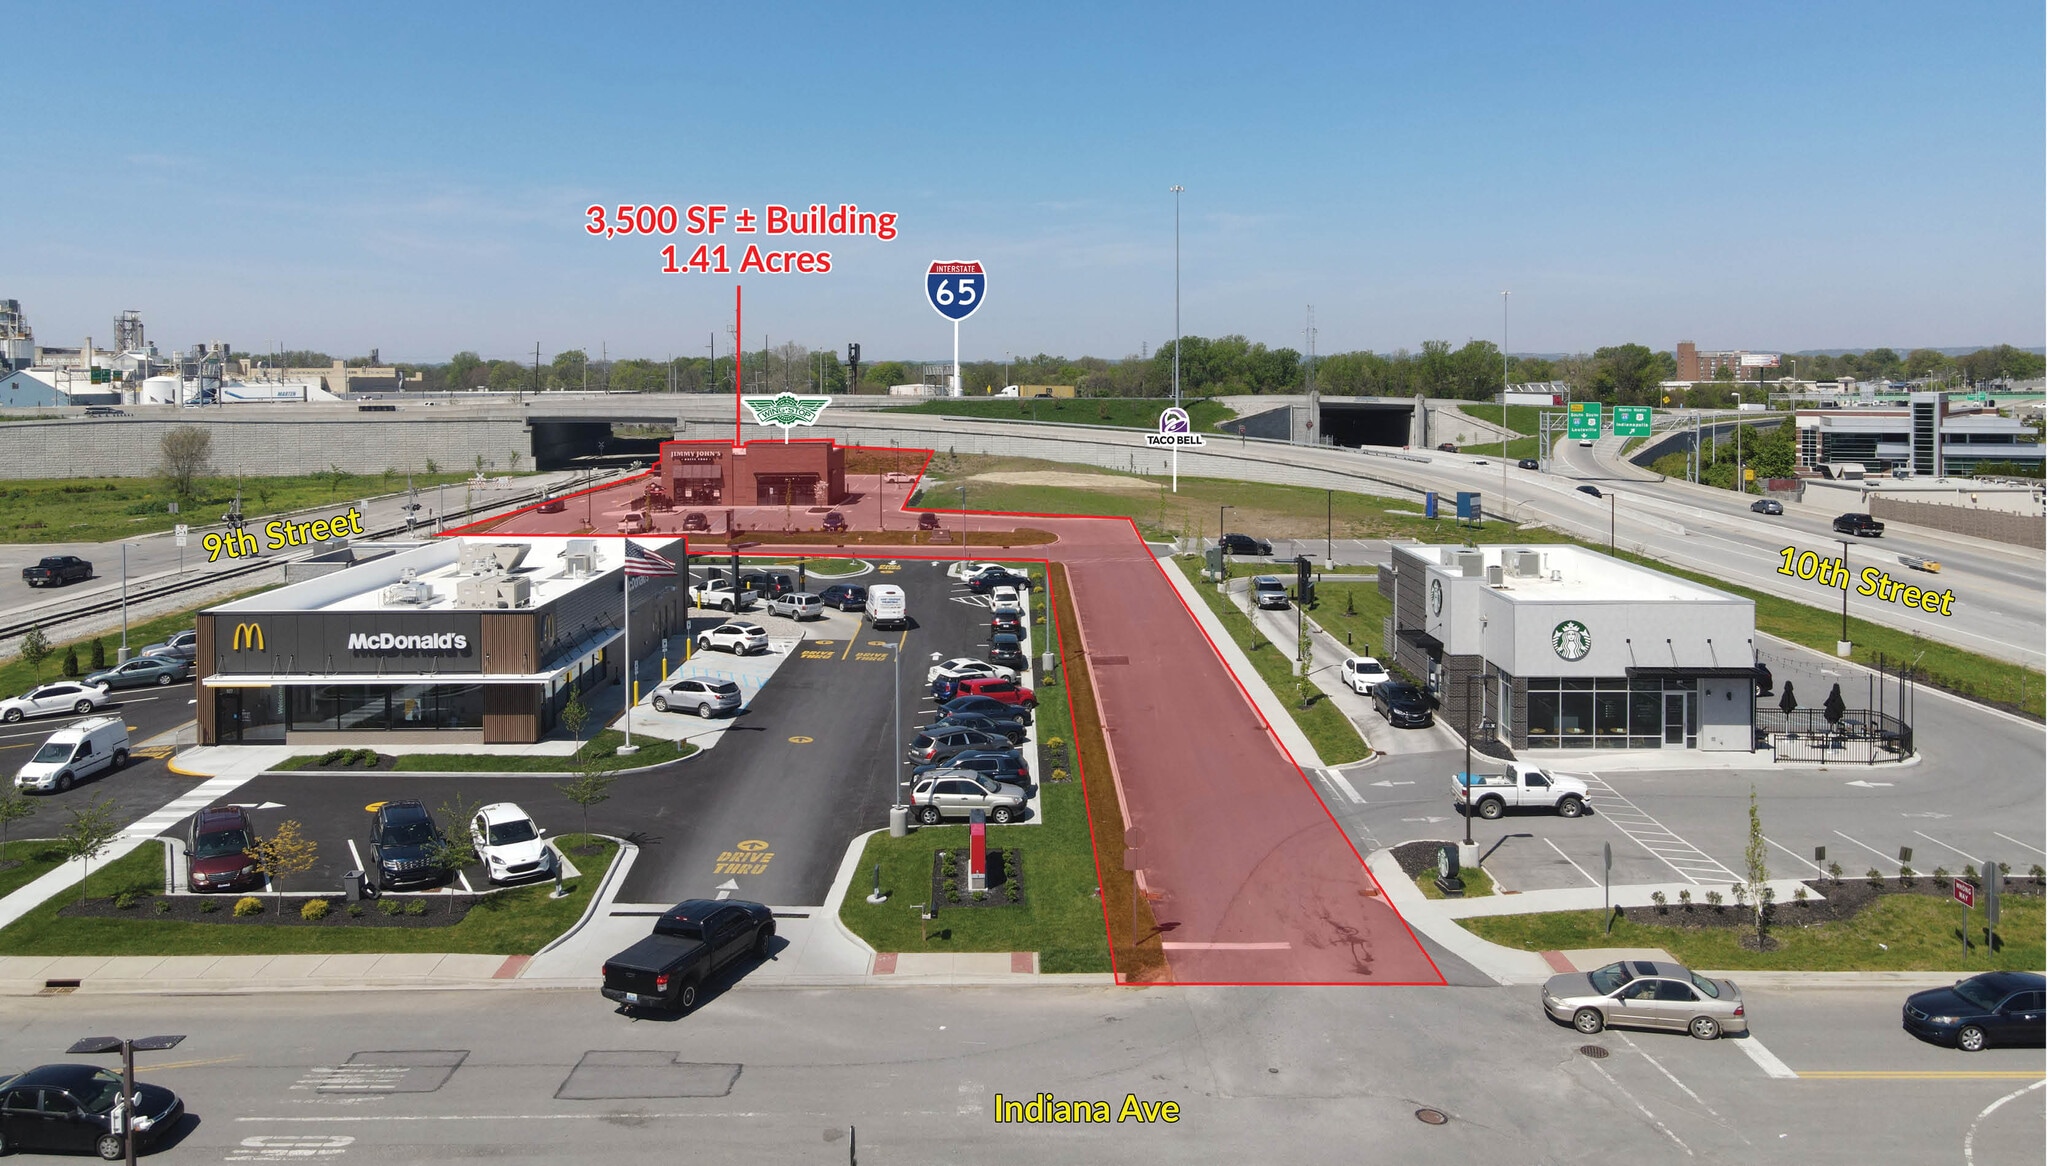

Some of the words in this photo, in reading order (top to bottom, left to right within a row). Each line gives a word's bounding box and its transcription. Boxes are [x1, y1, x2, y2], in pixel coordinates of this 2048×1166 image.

[348, 633, 467, 650] McDonald's
[716, 851, 775, 863] DRIVE
[713, 863, 768, 875] THRU
